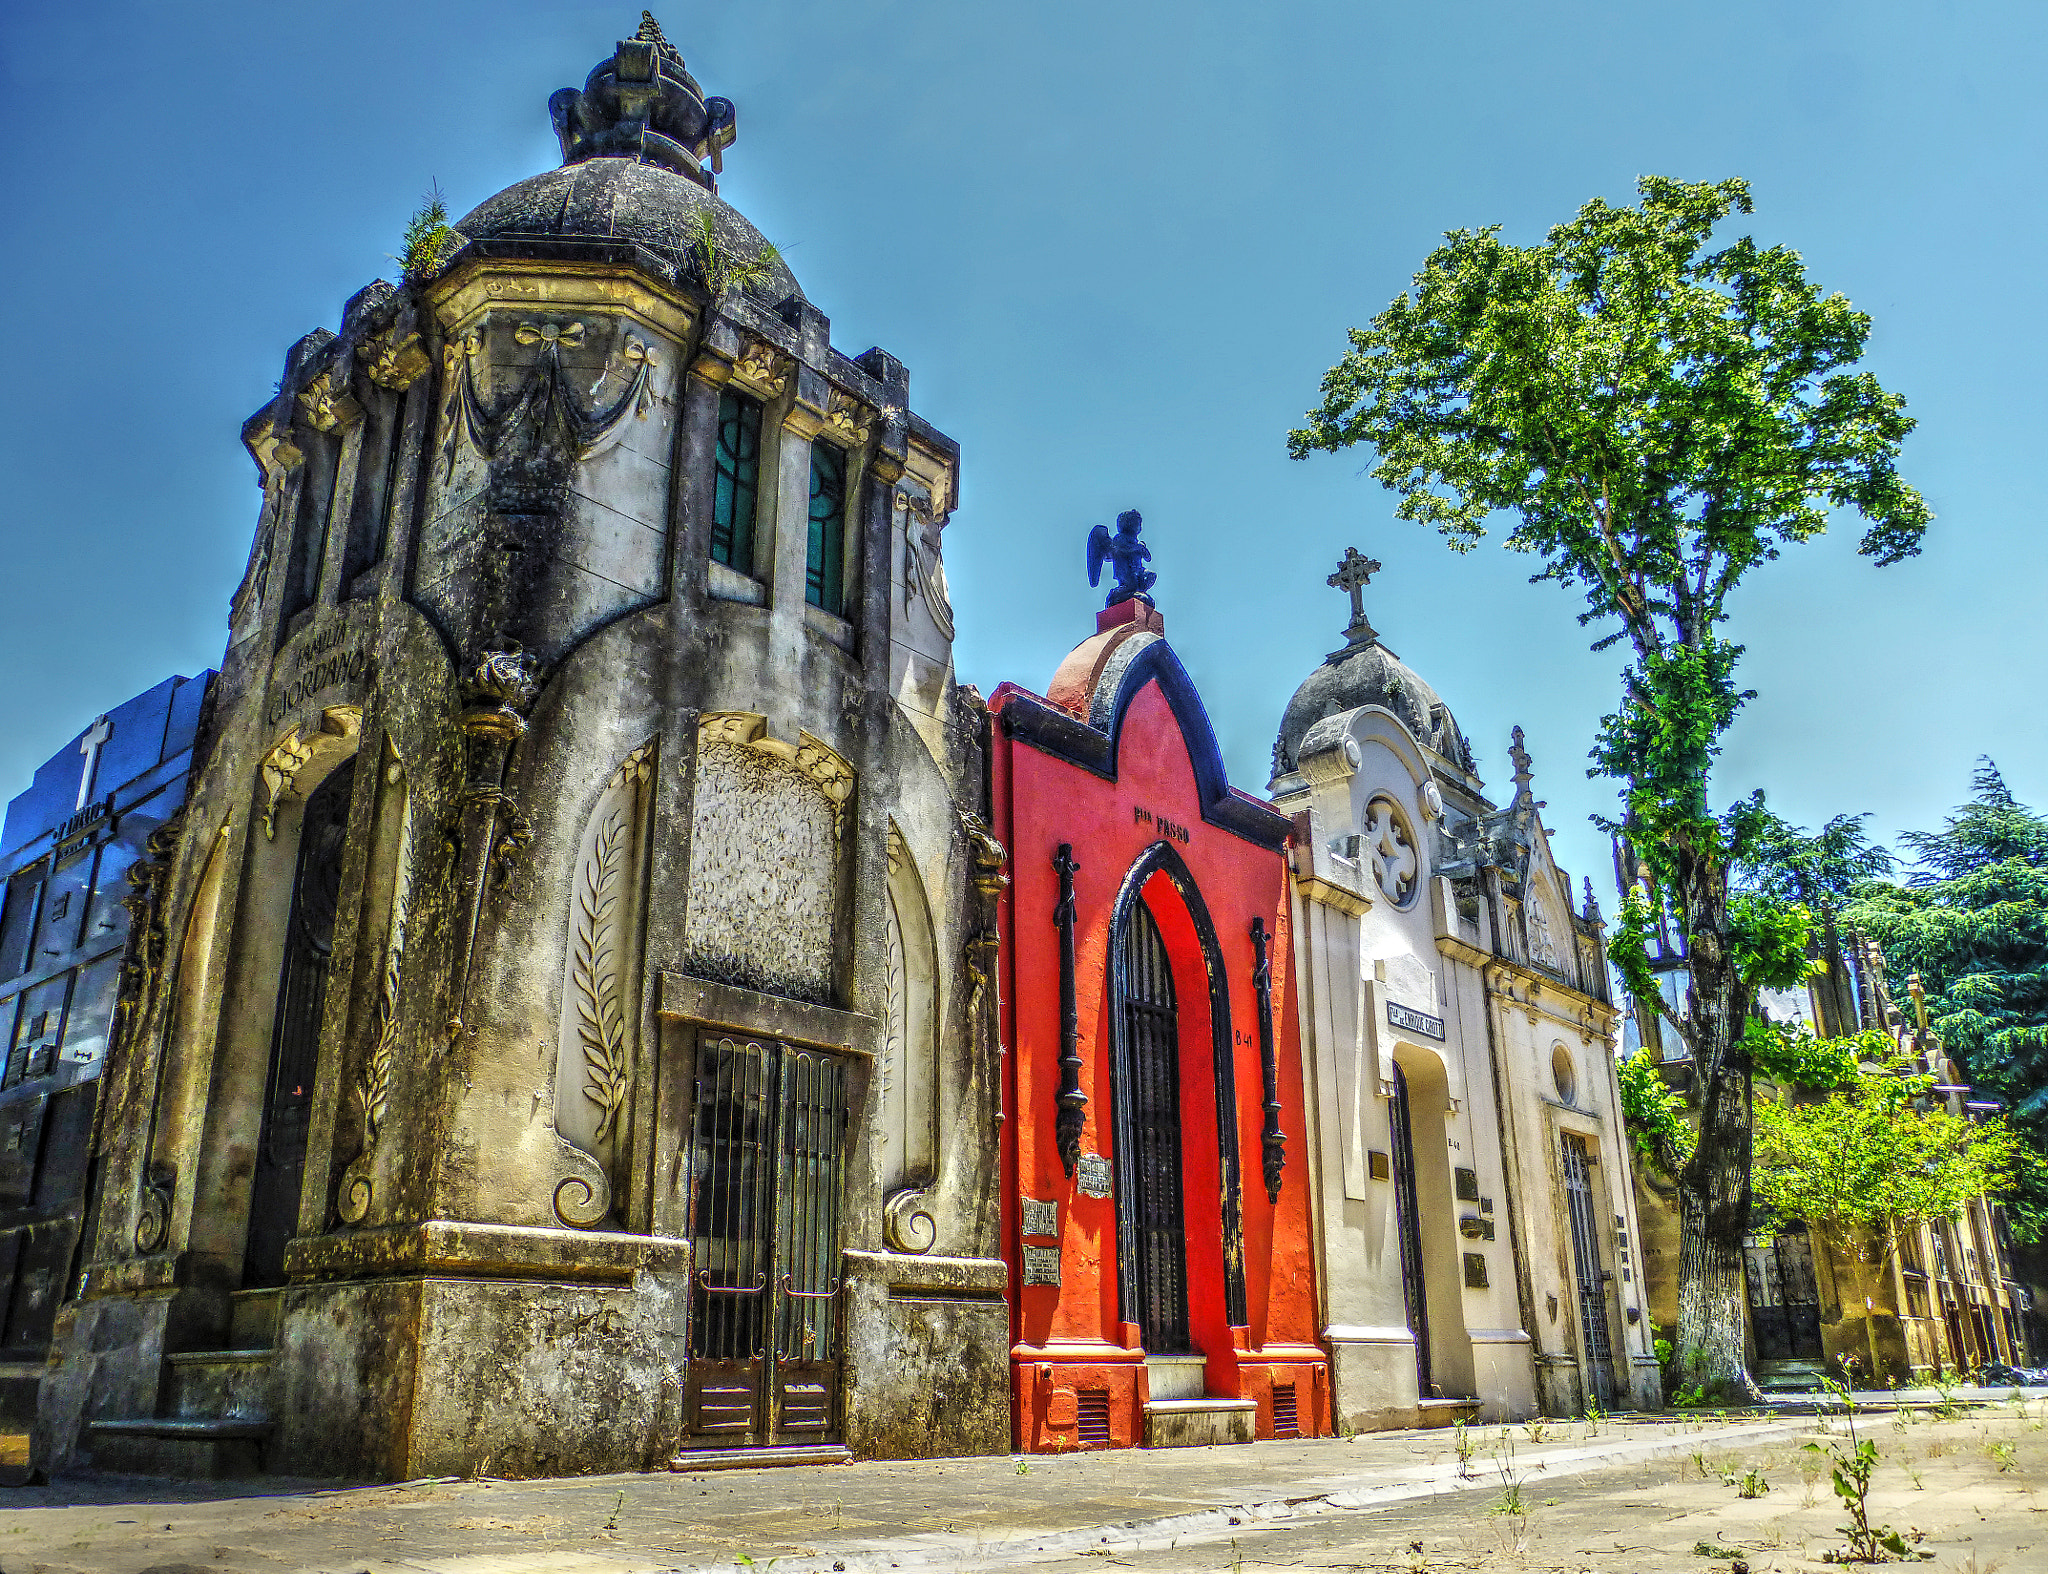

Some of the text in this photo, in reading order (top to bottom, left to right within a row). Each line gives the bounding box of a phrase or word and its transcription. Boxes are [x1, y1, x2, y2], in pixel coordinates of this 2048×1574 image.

[268, 648, 364, 725] GIORDANO
[1156, 816, 1189, 843] PASSO
[1235, 1029, 1252, 1048] B 41
